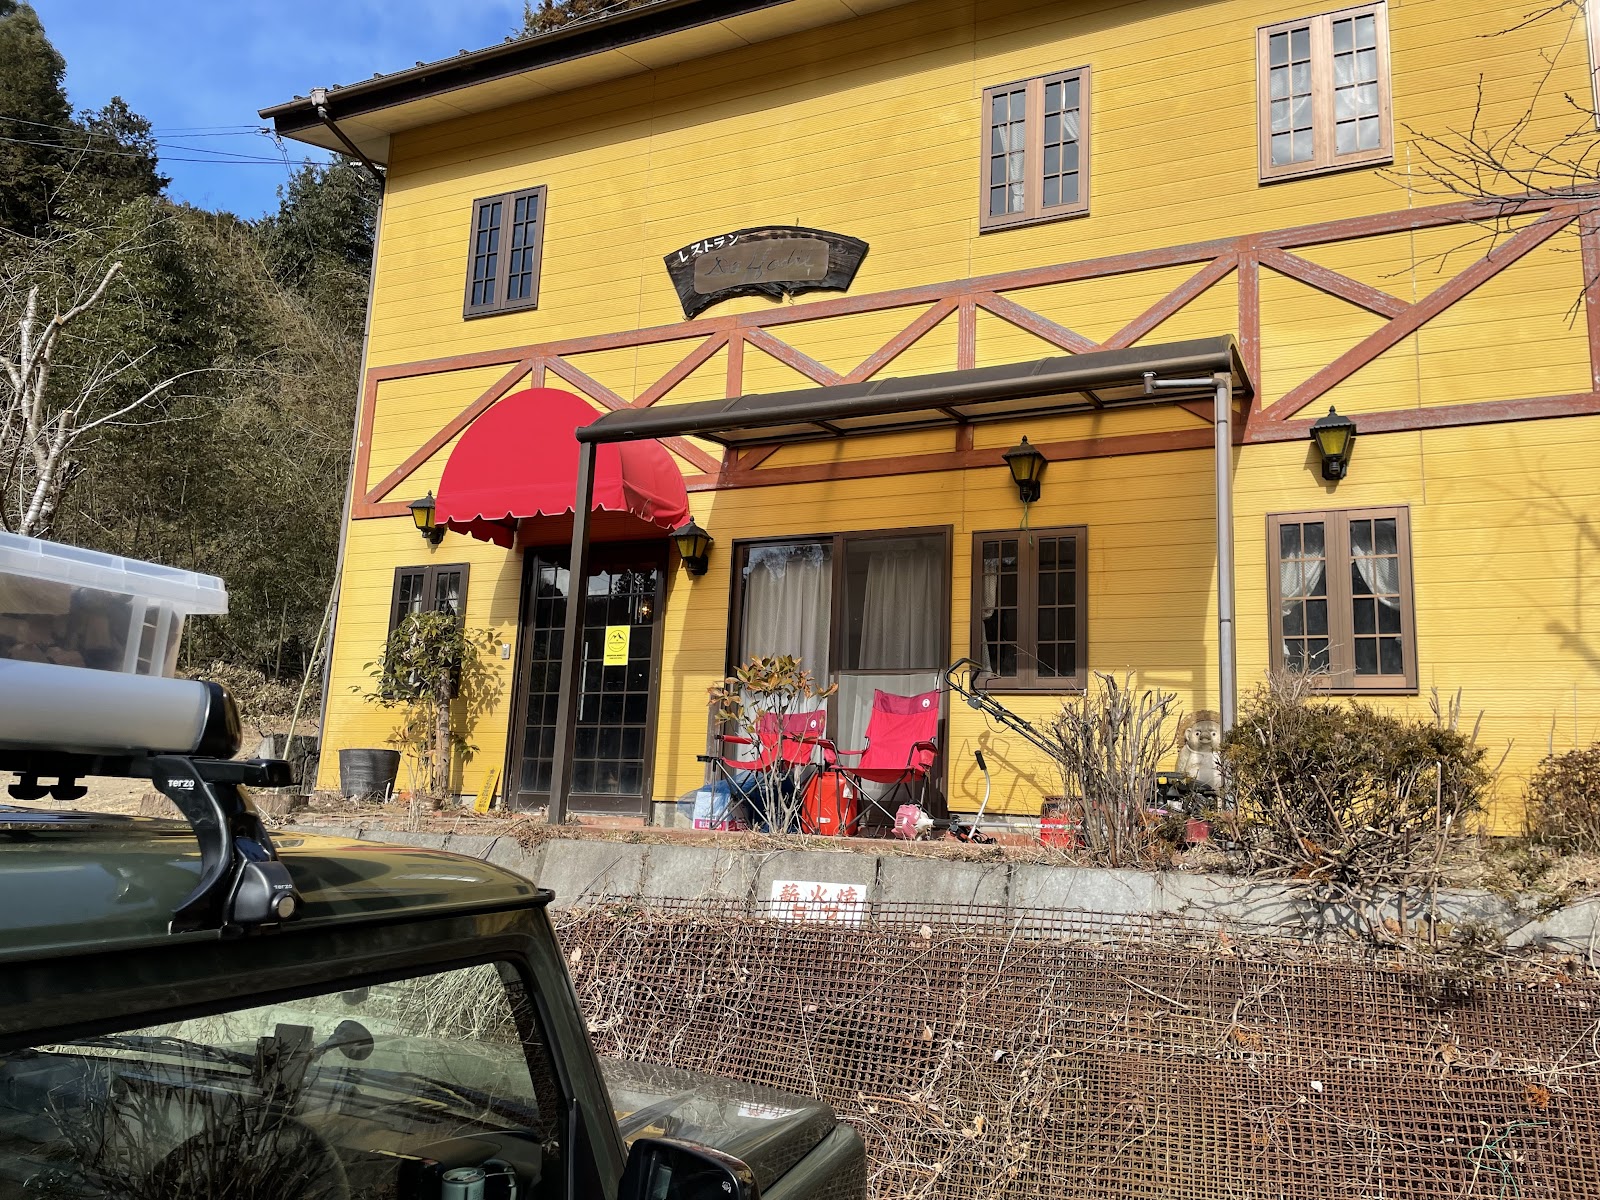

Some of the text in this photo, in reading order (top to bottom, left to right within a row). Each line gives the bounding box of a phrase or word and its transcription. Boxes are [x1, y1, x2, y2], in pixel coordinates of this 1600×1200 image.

[678, 234, 739, 263] レストラン
[167, 779, 195, 788] Terzo
